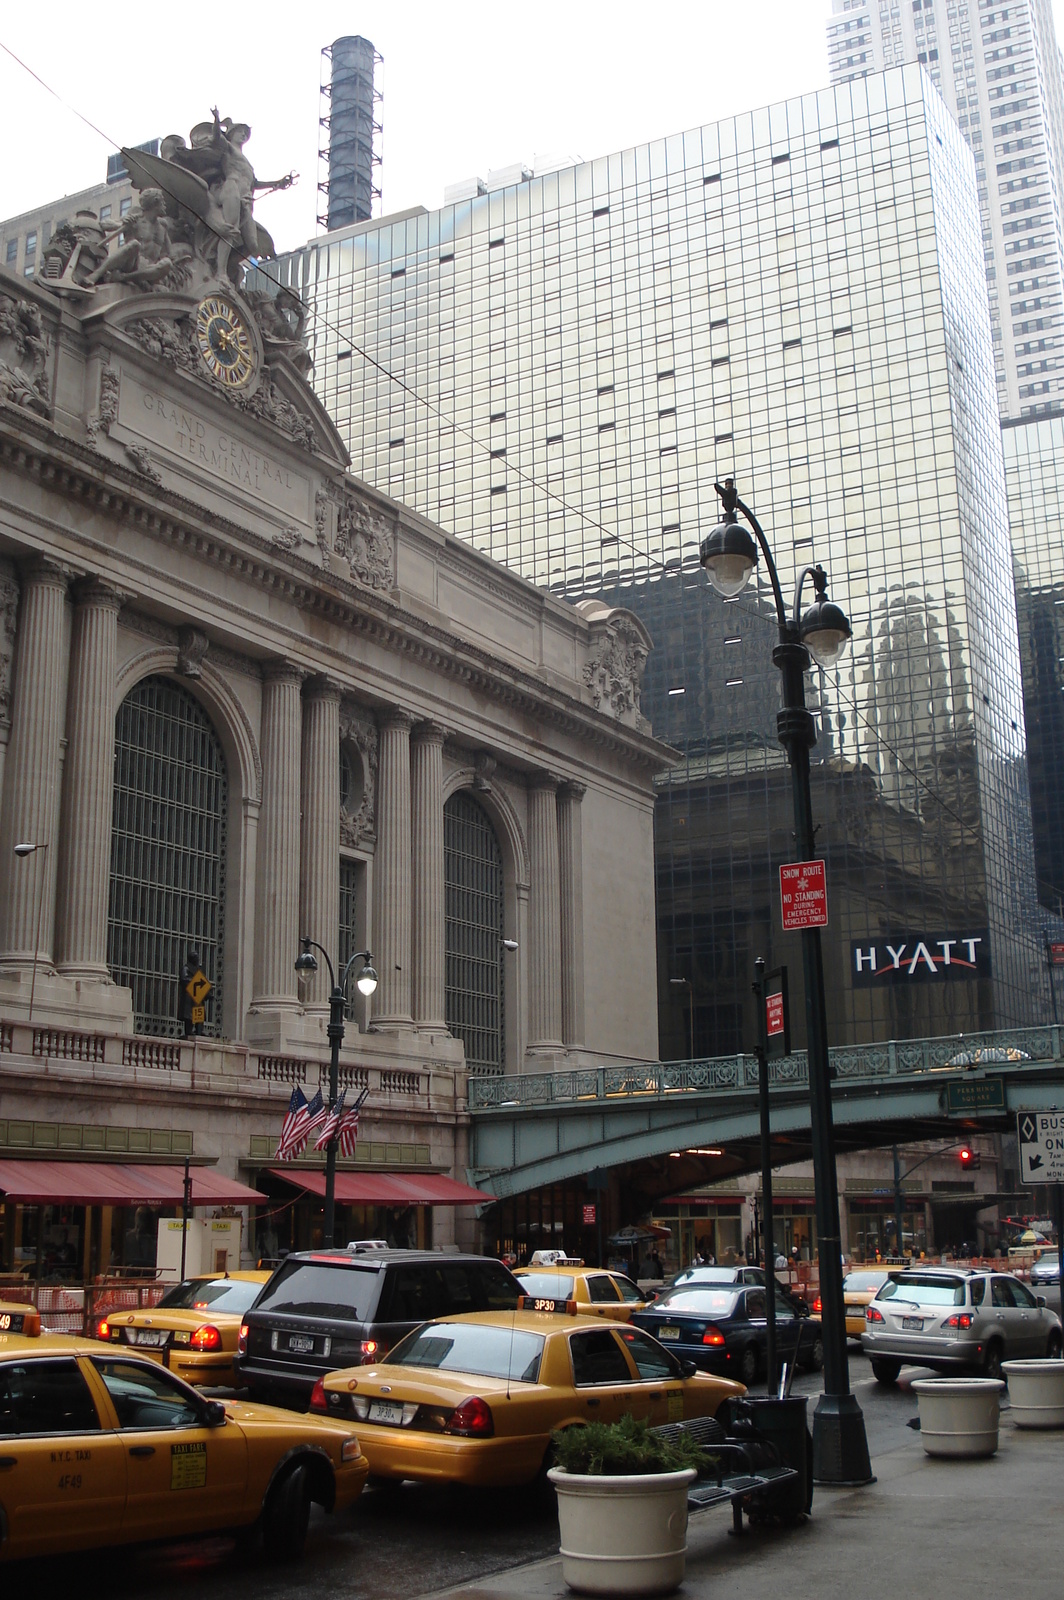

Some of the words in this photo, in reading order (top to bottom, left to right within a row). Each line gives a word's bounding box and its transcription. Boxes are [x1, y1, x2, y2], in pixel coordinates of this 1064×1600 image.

[143, 393, 206, 439] GRAND
[218, 436, 292, 490] CENTRAL
[176, 431, 262, 491] TERMINAL
[782, 868, 800, 879] SNOW
[803, 865, 822, 876] ROUTE
[783, 893, 792, 904] NO
[795, 890, 824, 902] STANDING
[793, 901, 815, 910] DURING
[787, 908, 822, 918] EMERGENCY
[784, 917, 807, 926] VEHICLES
[809, 914, 826, 923] TOWED
[856, 938, 982, 974] HYATT
[194, 1008, 203, 1017] 15
[957, 1085, 995, 1094] PERSHING
[962, 1094, 990, 1102] SQUARE
[534, 1299, 555, 1311] 3P30
[174, 1445, 188, 1453] TAXI
[190, 1443, 204, 1452] FARE
[75, 1449, 91, 1460] TAXI
[58, 1475, 82, 1490] 4F49
